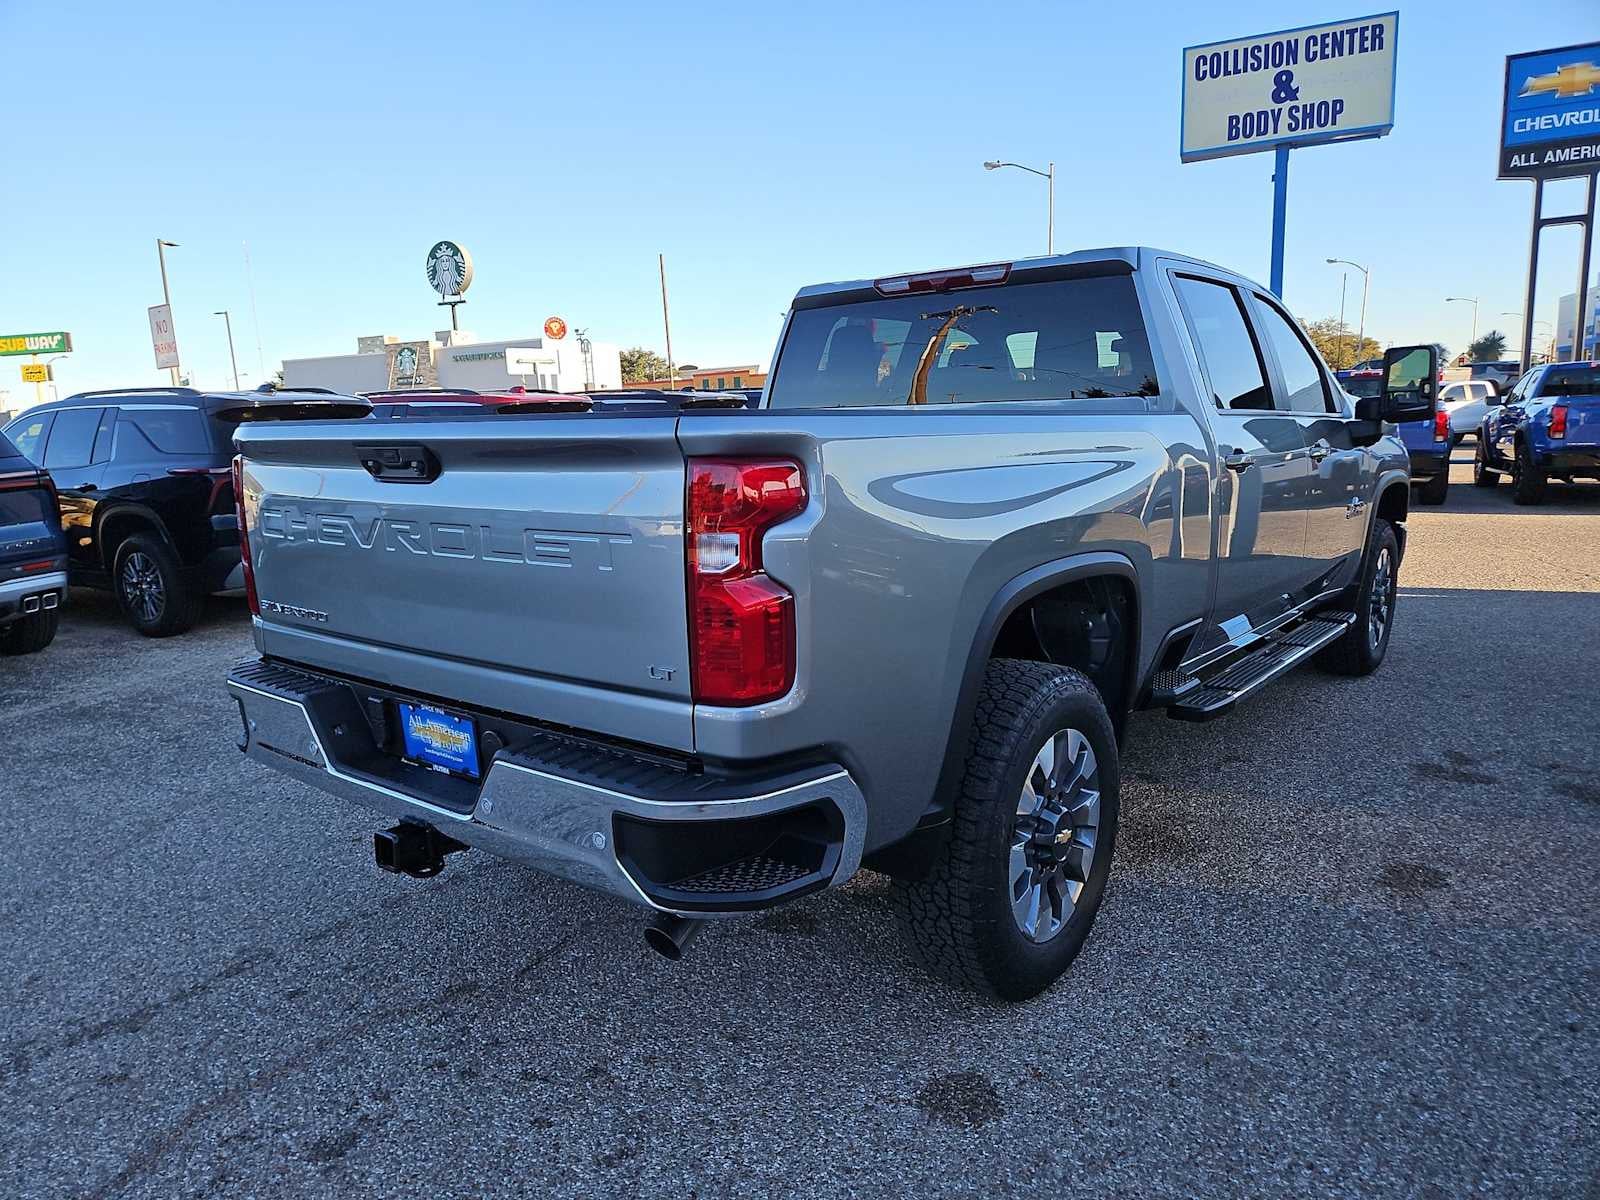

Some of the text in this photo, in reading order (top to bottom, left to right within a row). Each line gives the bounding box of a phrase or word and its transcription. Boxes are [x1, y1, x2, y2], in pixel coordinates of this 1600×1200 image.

[1195, 23, 1385, 81] COLLISION CENTER
[1271, 69, 1300, 104] &
[1227, 99, 1345, 141] BODY SHOP
[1509, 151, 1540, 168] ALL
[155, 319, 168, 334] NO
[0, 335, 61, 352] SUBWAY
[262, 507, 634, 571] CHEVROLET
[260, 600, 330, 622] SILVERADO
[647, 664, 677, 681] LT
[408, 714, 423, 728] All
